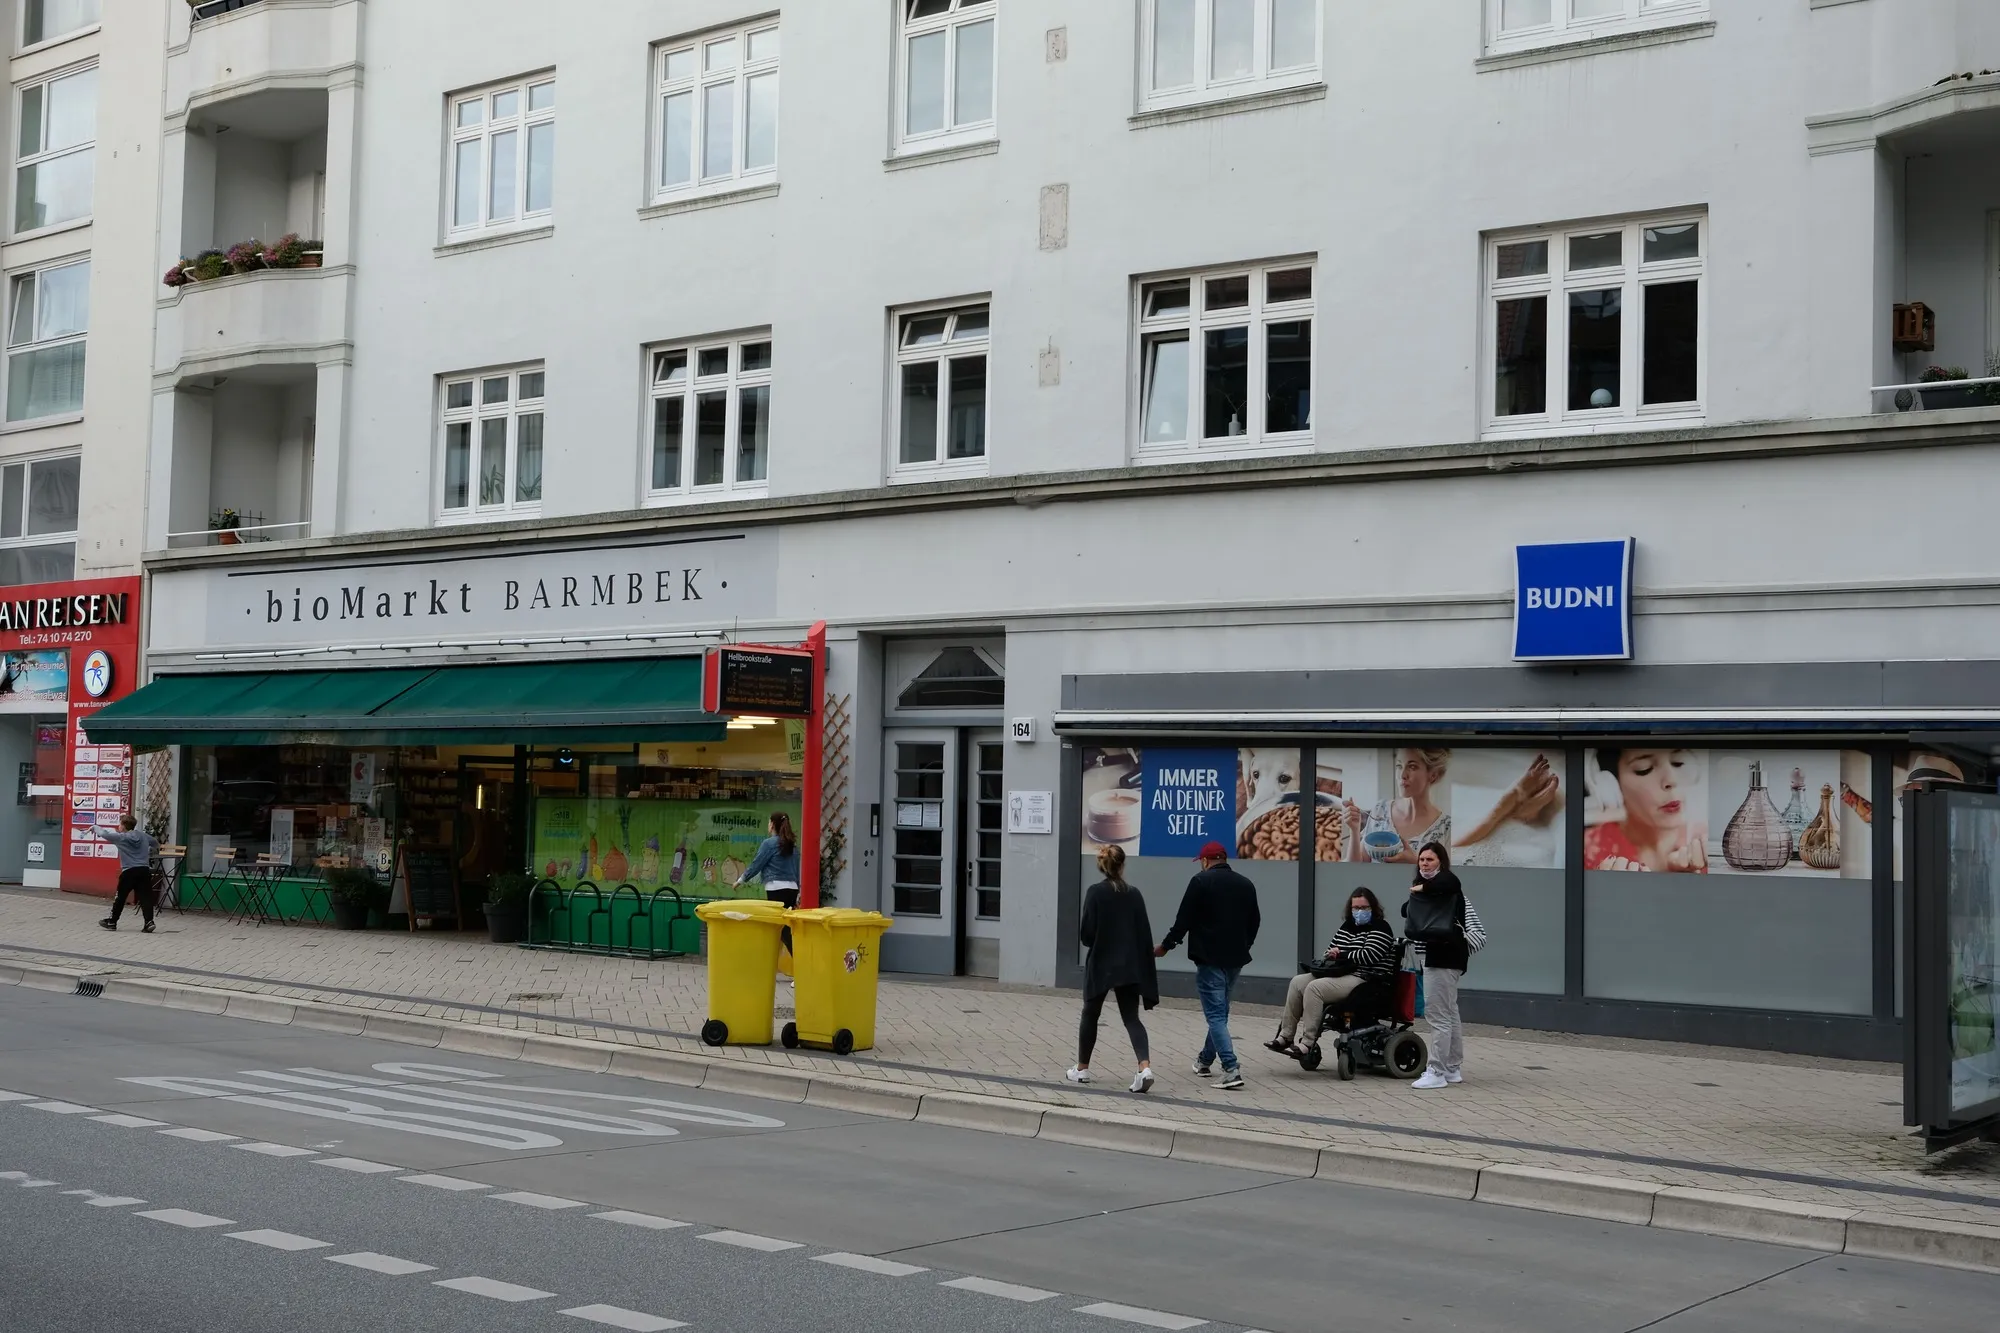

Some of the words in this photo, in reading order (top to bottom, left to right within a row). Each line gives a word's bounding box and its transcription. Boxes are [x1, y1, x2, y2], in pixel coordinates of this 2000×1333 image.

[267, 579, 471, 623] bioMarkt
[504, 567, 703, 611] BARMBEK
[1526, 585, 1614, 609] BUDNI
[36, 593, 124, 628] REISEN
[37, 634, 48, 643] 74
[49, 633, 60, 643] 10
[61, 632, 73, 642] 74
[74, 631, 92, 641] 270
[728, 653, 773, 664] Hellbrookstraße
[1012, 723, 1030, 736] 164
[1158, 768, 1218, 787] IMMER
[1152, 789, 1173, 811] AN
[1177, 789, 1226, 812] DEINER
[713, 814, 762, 831] Mitglieder
[1167, 813, 1209, 836] SEITE.
[115, 1061, 785, 1151] BUS
